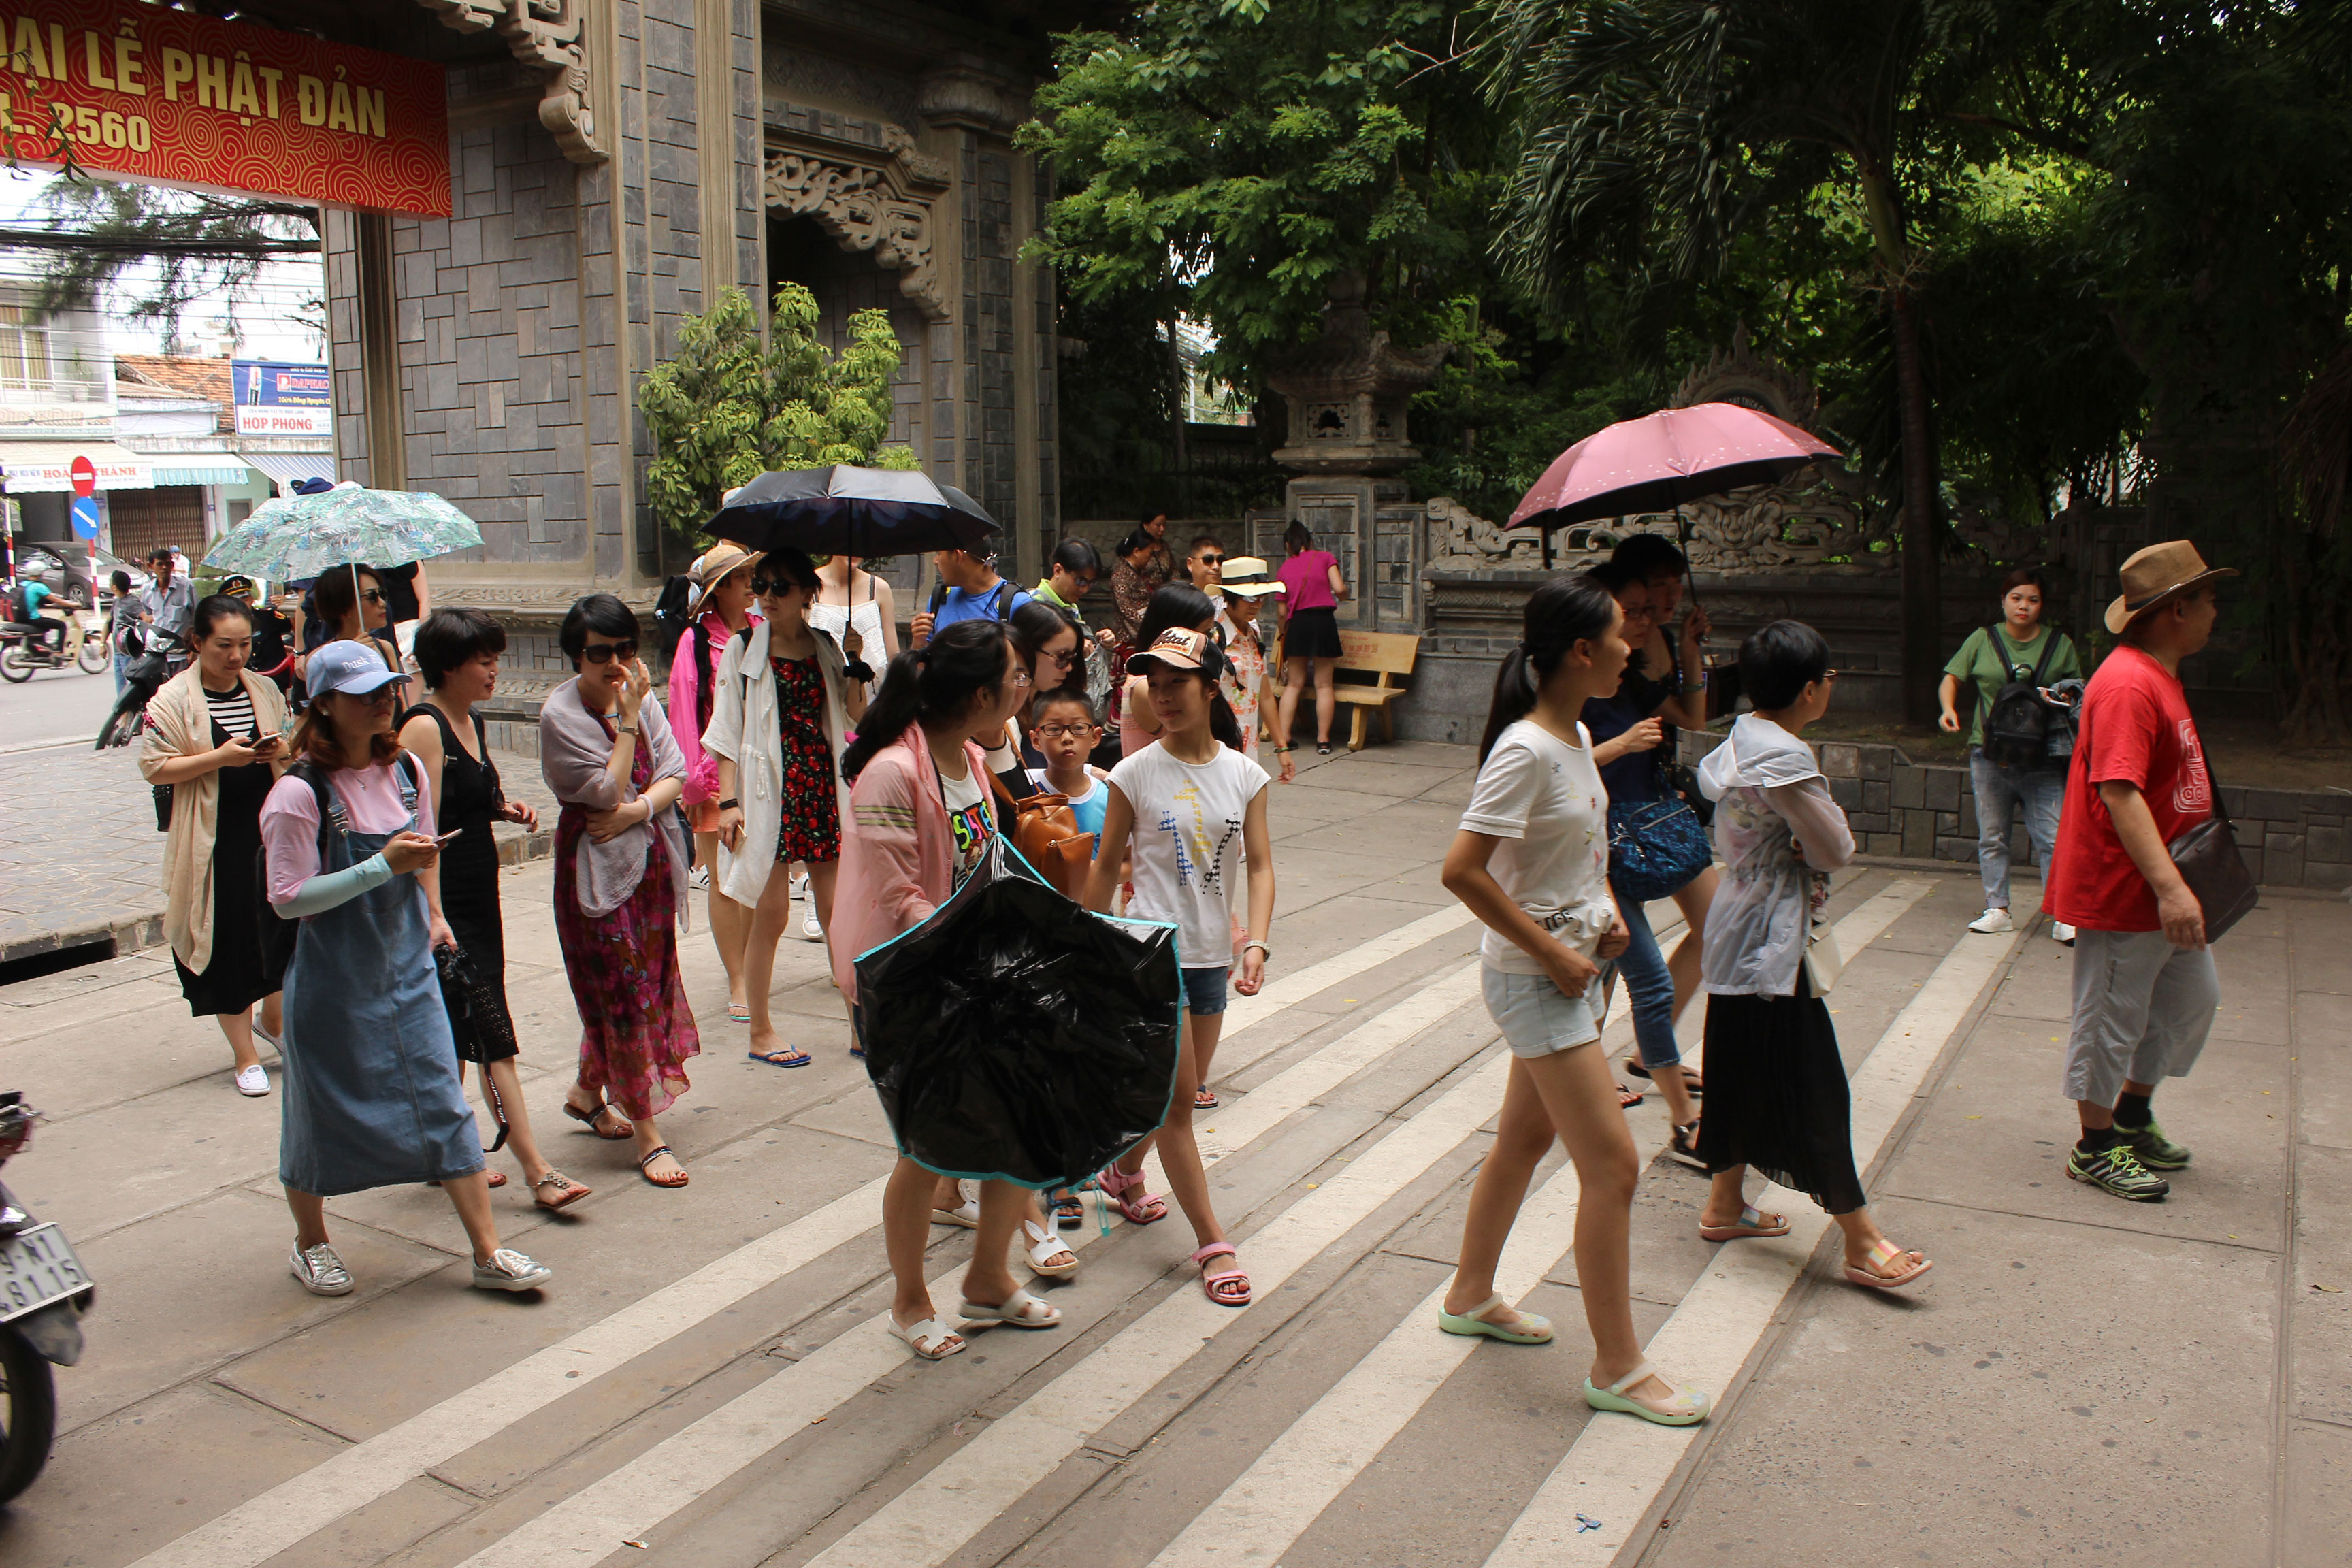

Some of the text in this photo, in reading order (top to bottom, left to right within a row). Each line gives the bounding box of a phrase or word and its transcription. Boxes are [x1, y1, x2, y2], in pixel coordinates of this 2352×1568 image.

[0, 16, 386, 138] ẠI LỄ PHẬT ĐẢN
[49, 102, 152, 154] 2560
[272, 417, 312, 430] PHONG
[94, 465, 137, 478] THÀNH
[340, 656, 370, 673] Dusk
